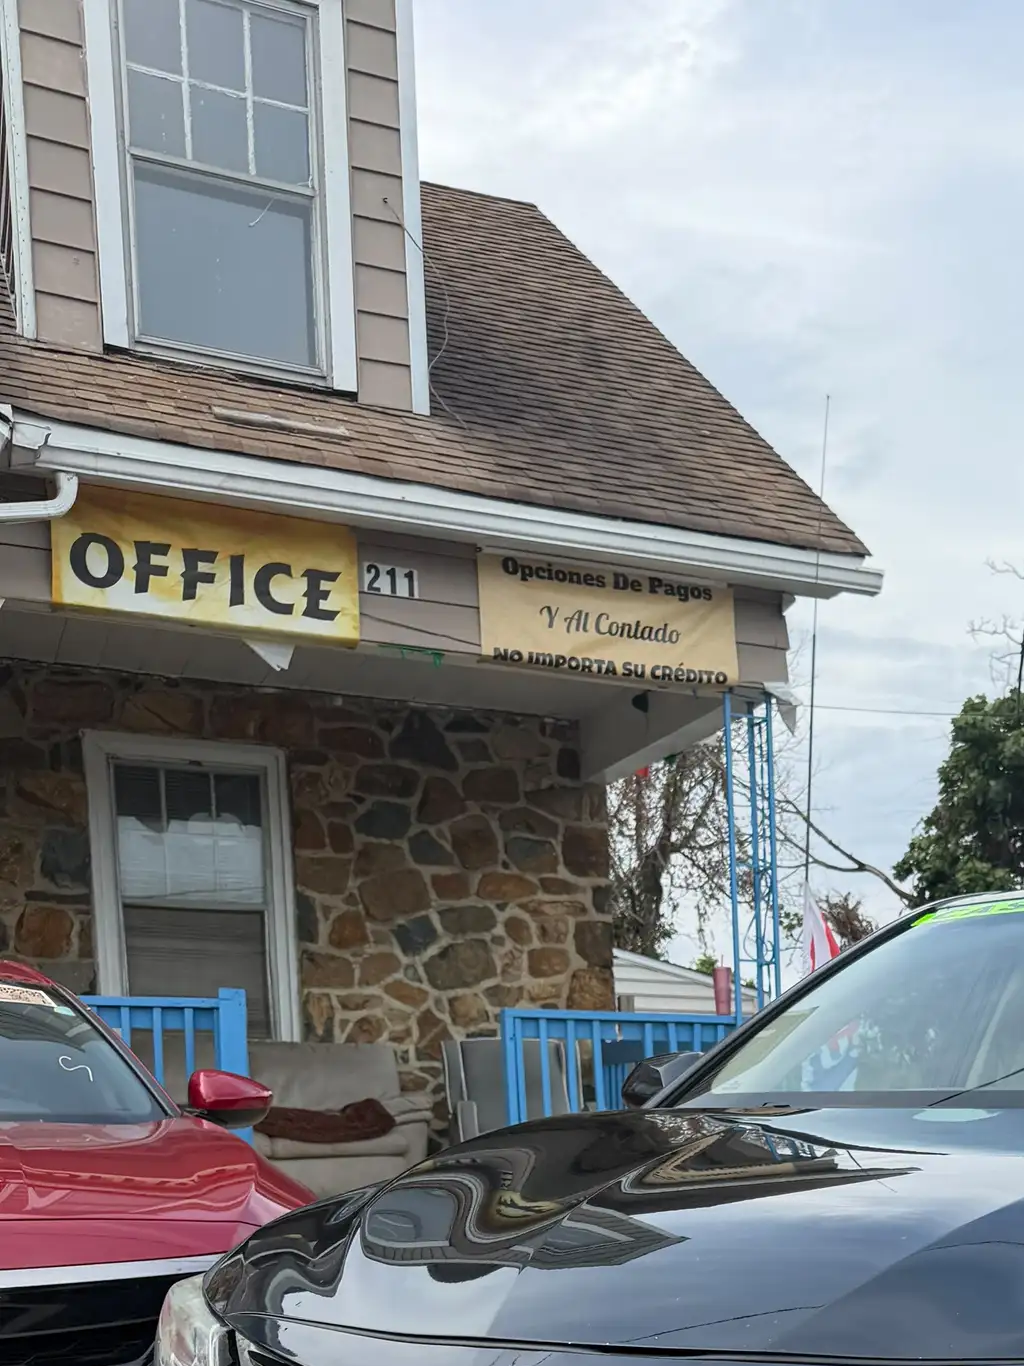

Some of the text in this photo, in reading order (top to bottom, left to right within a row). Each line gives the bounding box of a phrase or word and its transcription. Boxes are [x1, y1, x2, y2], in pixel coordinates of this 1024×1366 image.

[69, 532, 342, 622] OFFICE
[366, 562, 417, 598] 211
[501, 556, 713, 602] Opciones De Pagos
[539, 605, 682, 645] Y Al Contado
[493, 647, 728, 686] NO IMPORTA SU CRÉDITO
